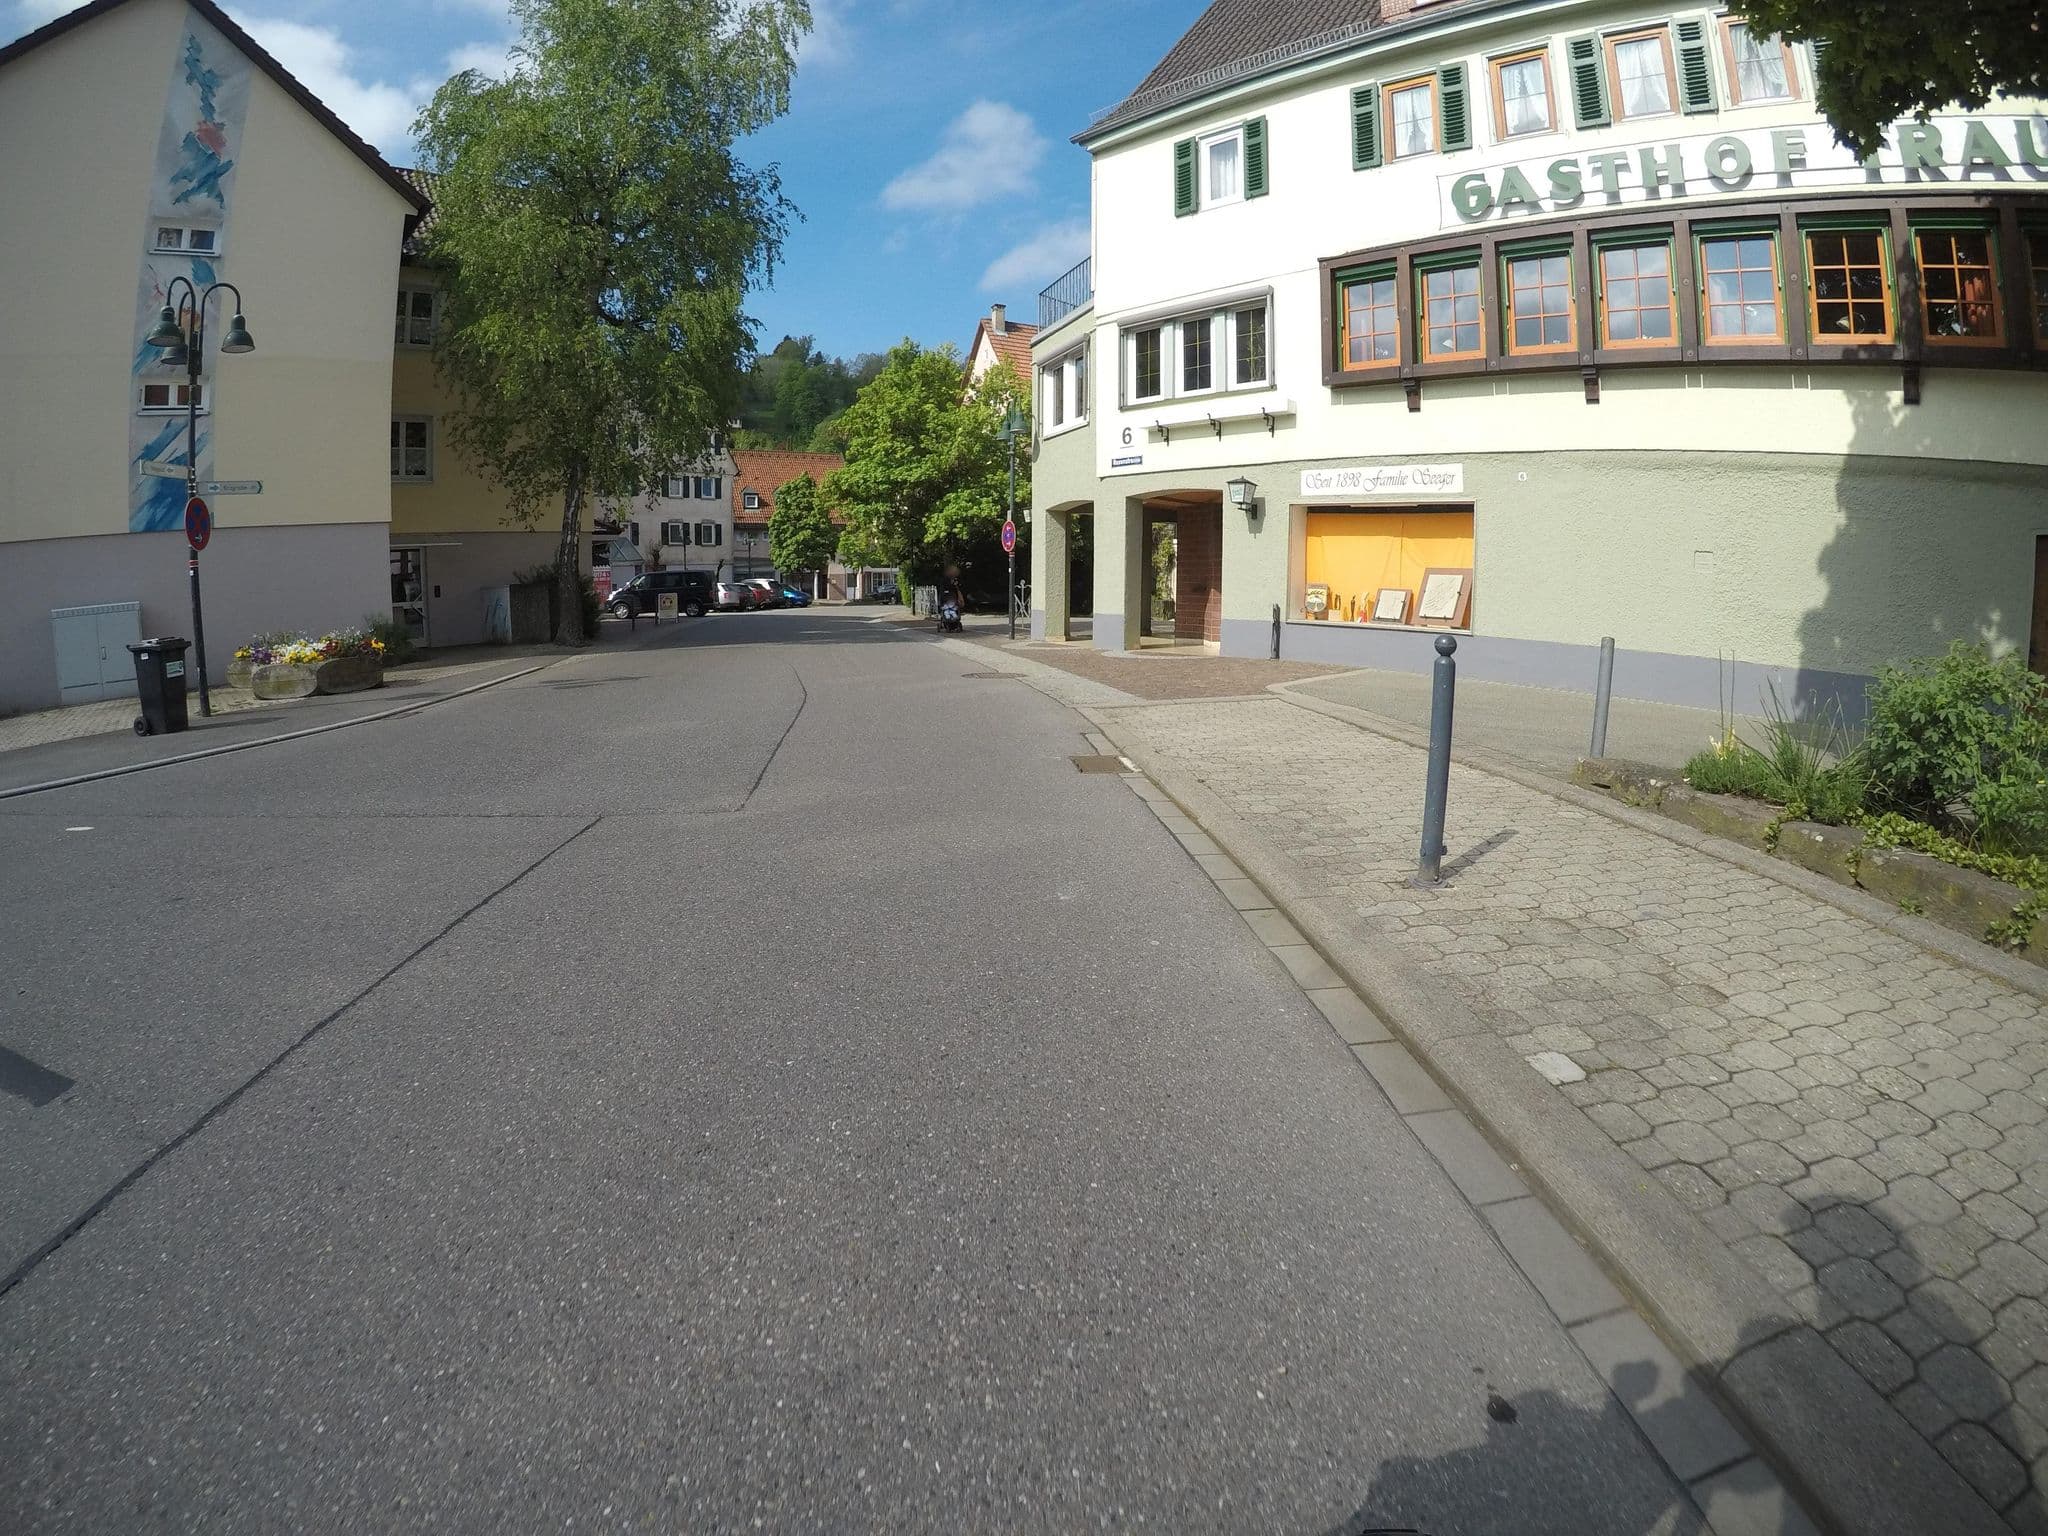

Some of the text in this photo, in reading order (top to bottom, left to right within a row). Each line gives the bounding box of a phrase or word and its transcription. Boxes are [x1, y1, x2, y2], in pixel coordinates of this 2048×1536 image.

[1450, 130, 1807, 216] GASTHOF
[1122, 427, 1132, 445] 6
[1306, 467, 1456, 493] Seit 1898 Familie Seeger
